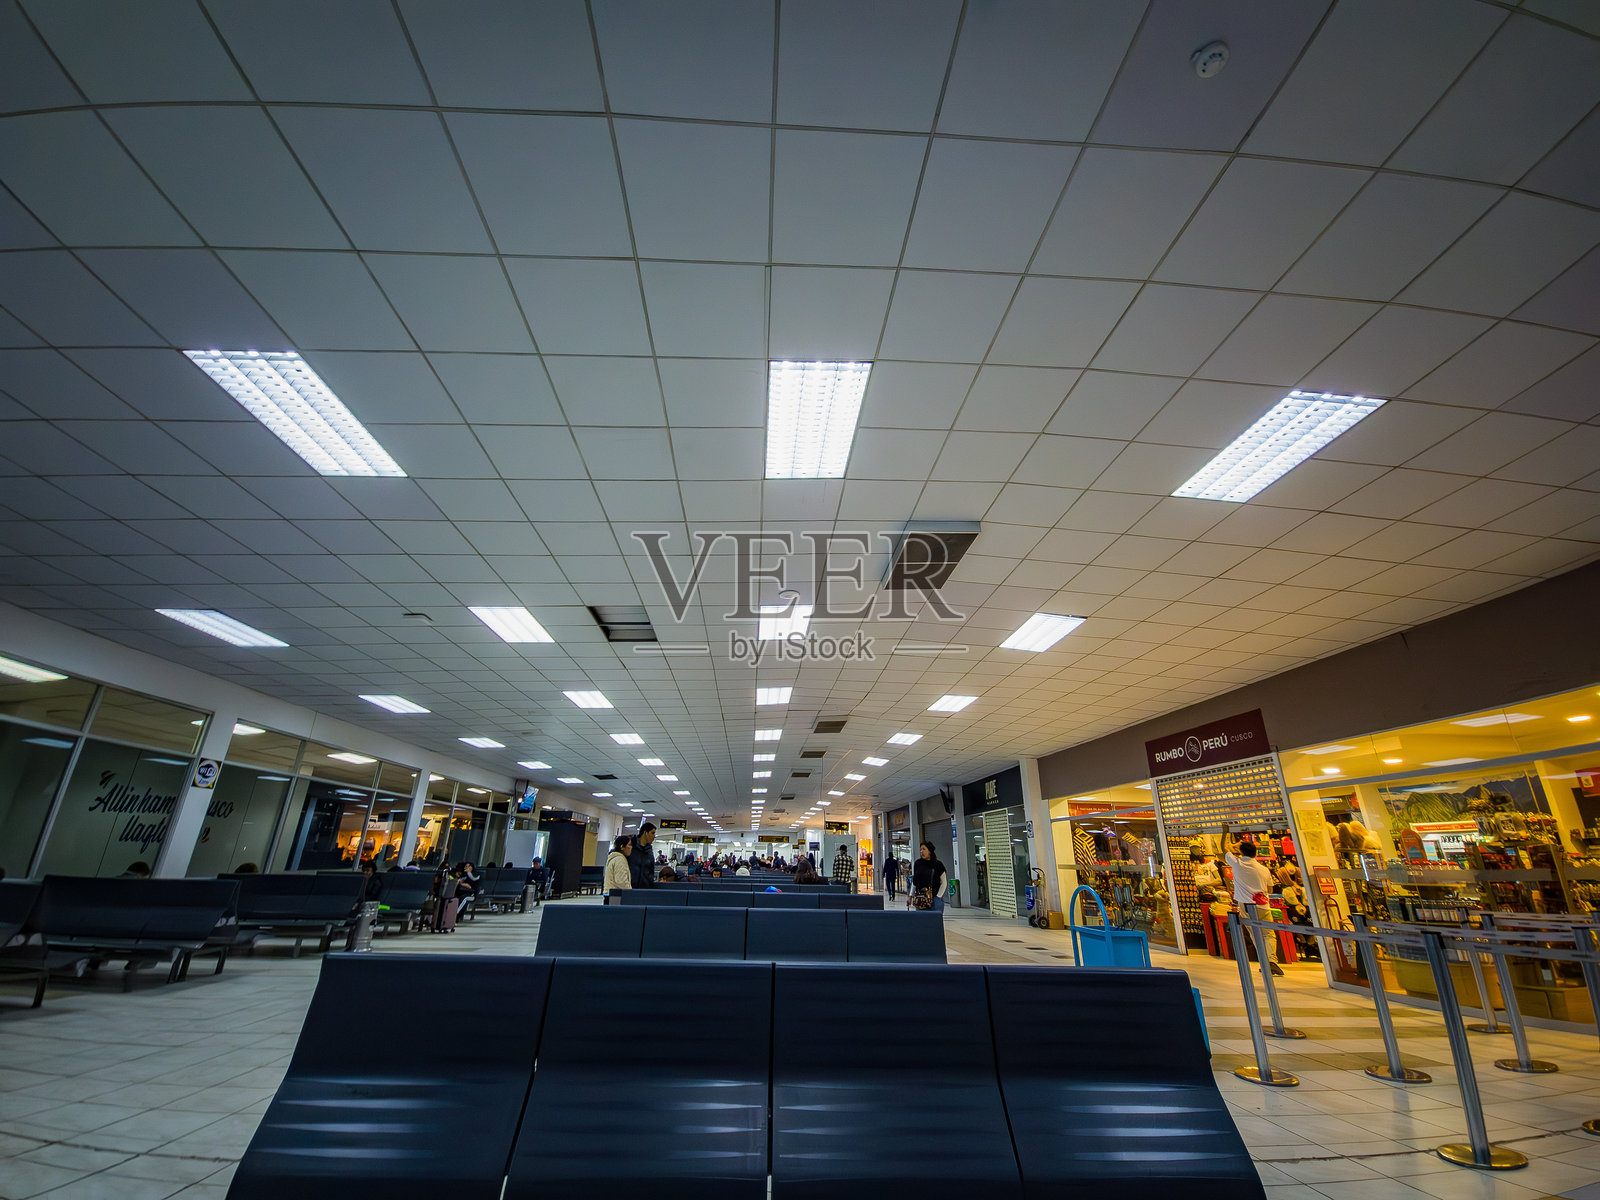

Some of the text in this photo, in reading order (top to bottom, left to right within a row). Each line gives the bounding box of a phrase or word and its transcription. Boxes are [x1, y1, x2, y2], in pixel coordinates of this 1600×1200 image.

[1155, 731, 1254, 763] RUMBO PERÚ CUSCO
[88, 782, 234, 818] Allinham usco
